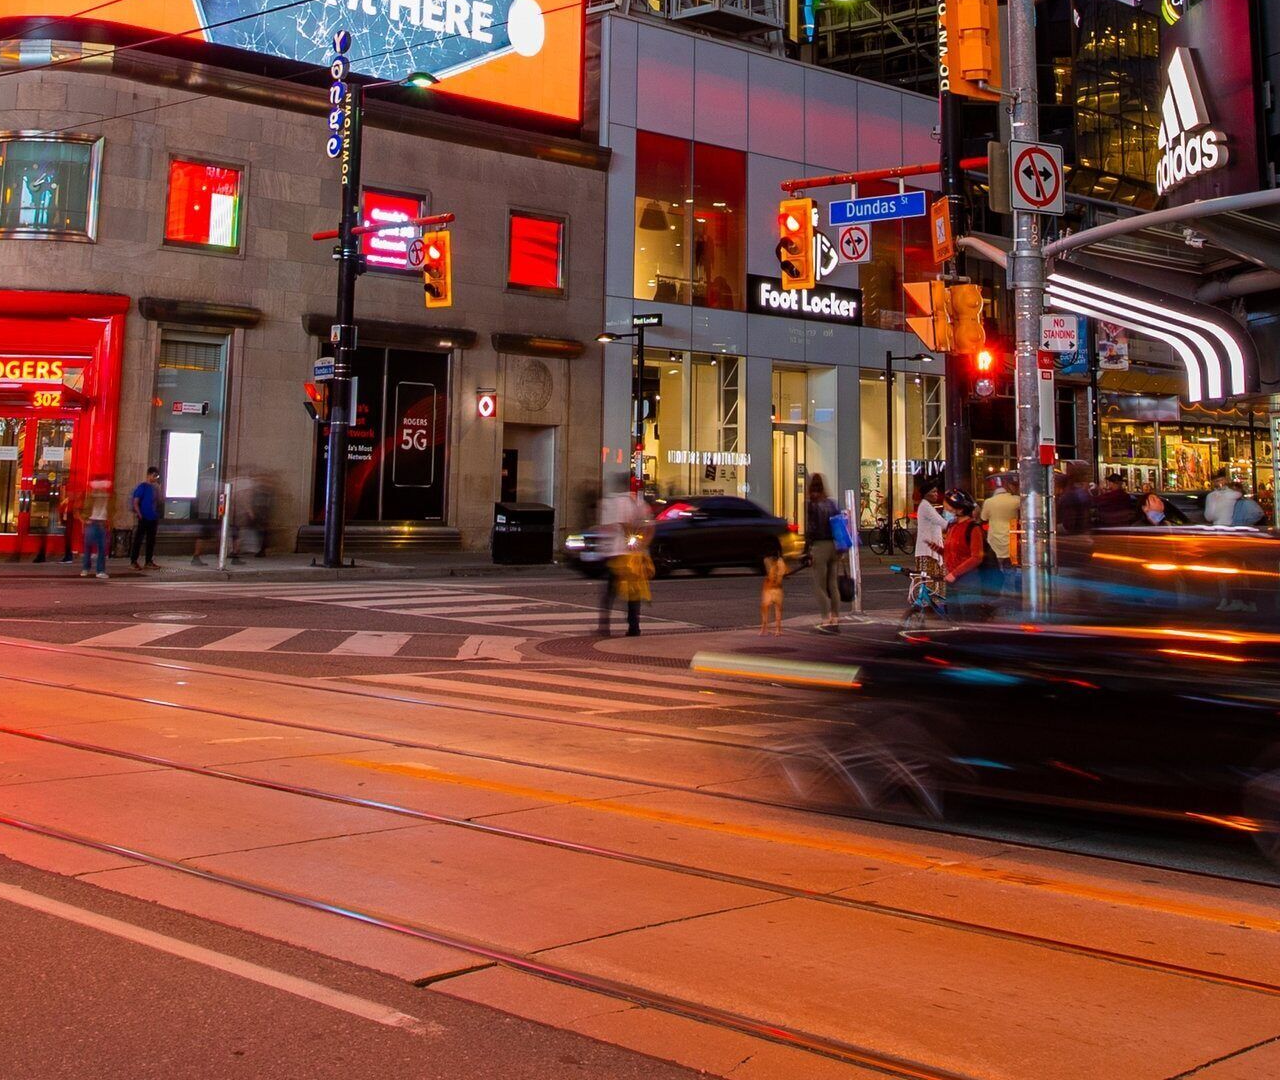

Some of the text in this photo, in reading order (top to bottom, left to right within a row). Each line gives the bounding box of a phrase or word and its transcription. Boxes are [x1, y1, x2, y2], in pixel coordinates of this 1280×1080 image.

[341, 92, 352, 185] DOWNTOWN
[1156, 129, 1219, 197] adidas
[846, 196, 909, 218] Dundas St
[760, 283, 857, 317] Foot Locker
[1053, 318, 1065, 328] NO
[1043, 329, 1076, 340] STANDING
[33, 392, 62, 407] 302
[403, 418, 428, 426] ROGERS
[401, 429, 428, 450] 5G
